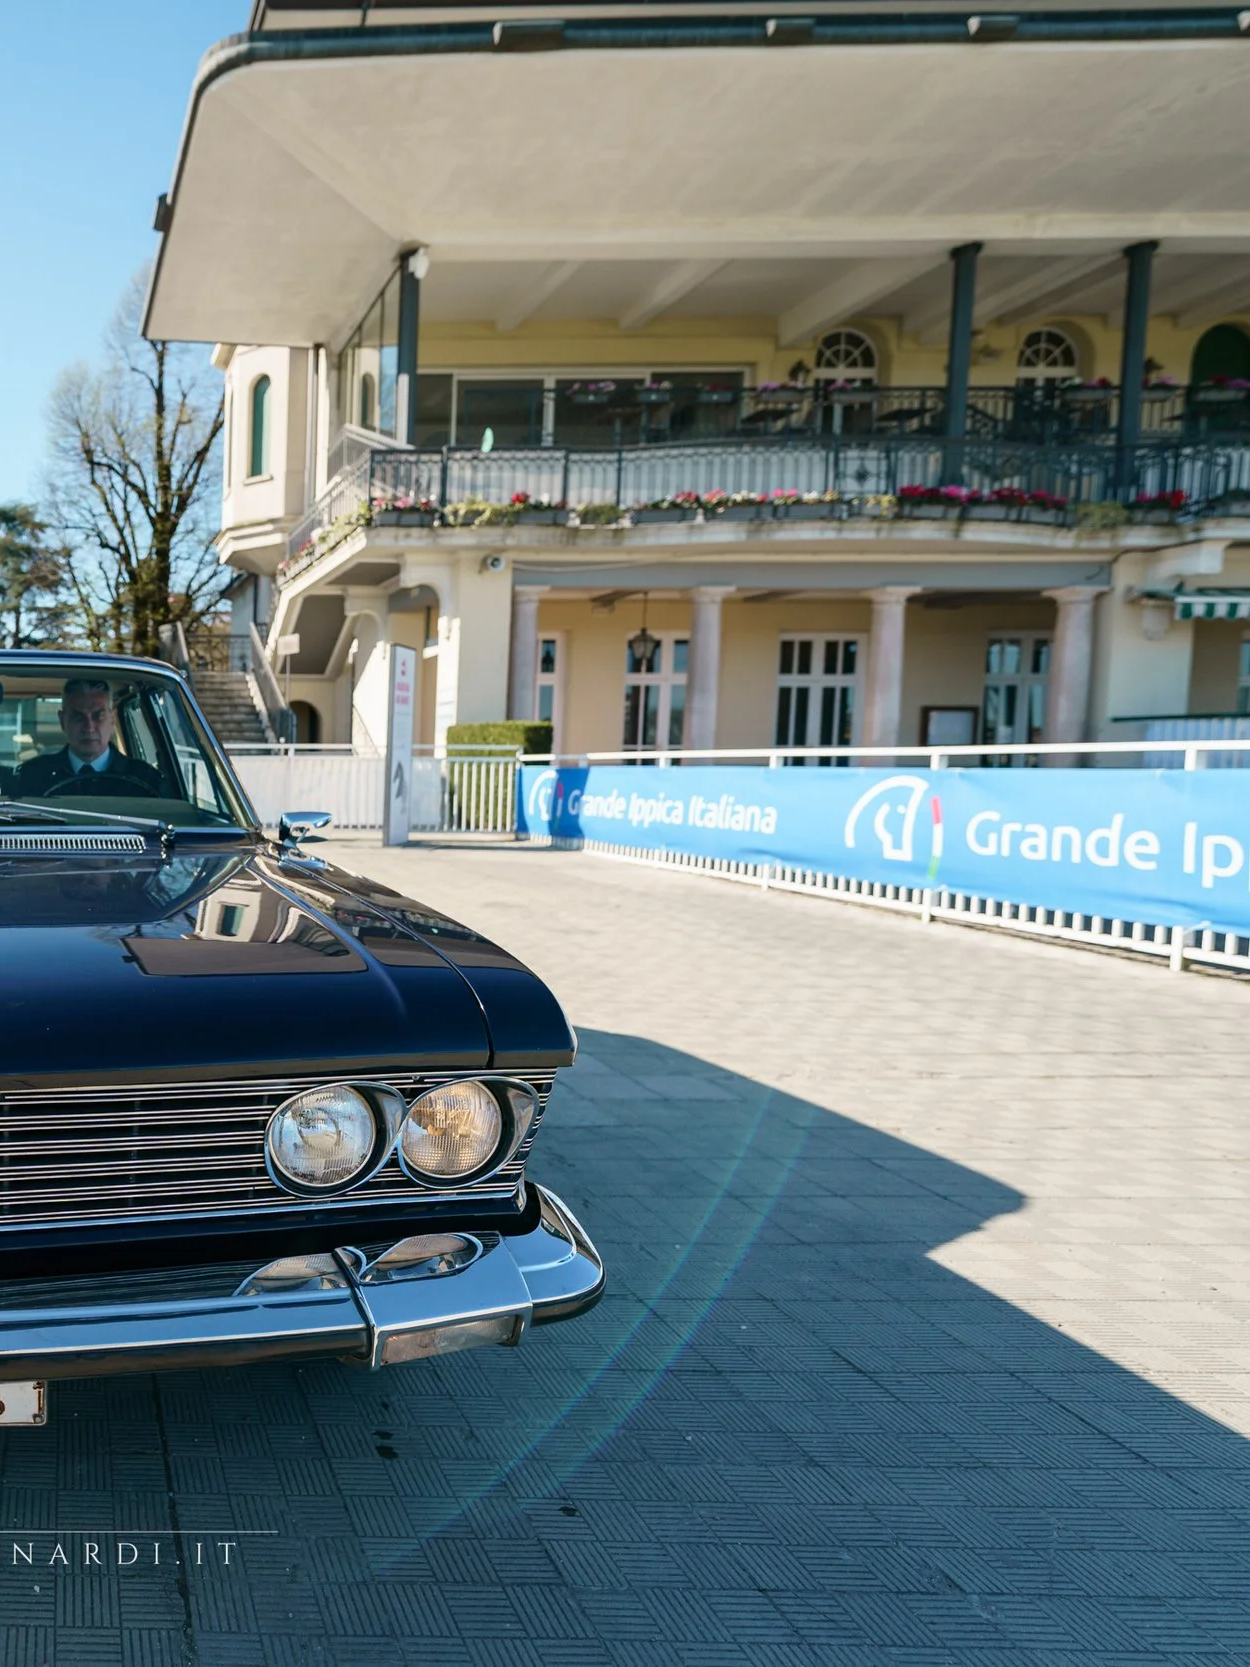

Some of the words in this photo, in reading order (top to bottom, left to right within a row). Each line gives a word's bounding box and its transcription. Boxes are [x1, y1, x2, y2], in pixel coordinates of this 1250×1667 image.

[567, 789, 626, 820] Grande
[628, 792, 683, 828] Ippica
[688, 794, 778, 835] Italiana
[965, 810, 1161, 871] Grande
[1182, 821, 1250, 890] Ip
